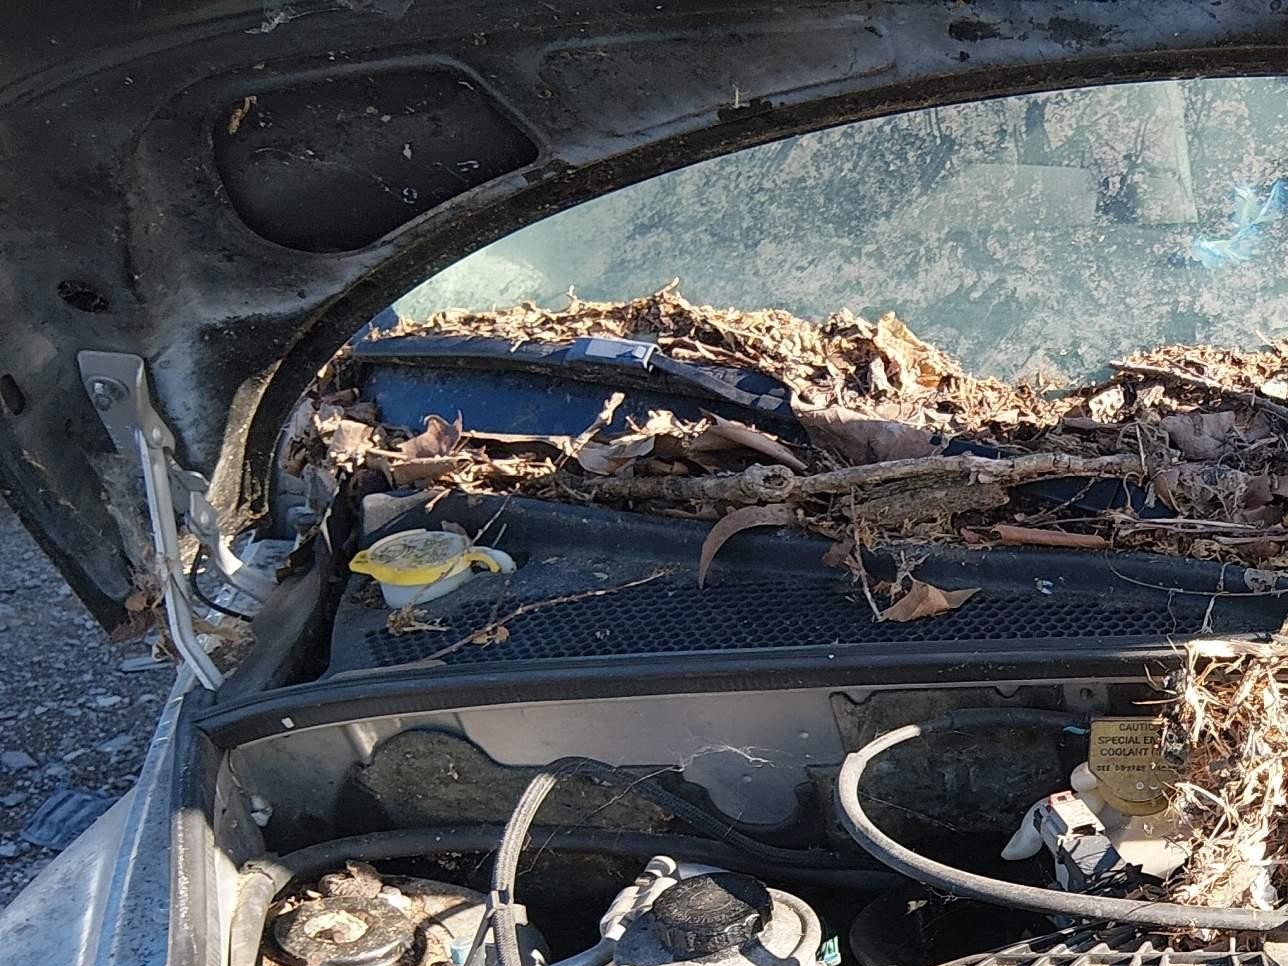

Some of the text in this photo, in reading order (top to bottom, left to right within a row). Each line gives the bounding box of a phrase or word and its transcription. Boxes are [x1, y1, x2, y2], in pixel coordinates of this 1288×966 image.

[1119, 723, 1158, 731] CAUTIO
[1098, 736, 1140, 744] SPECIAL
[1100, 748, 1149, 756] COOLANT
